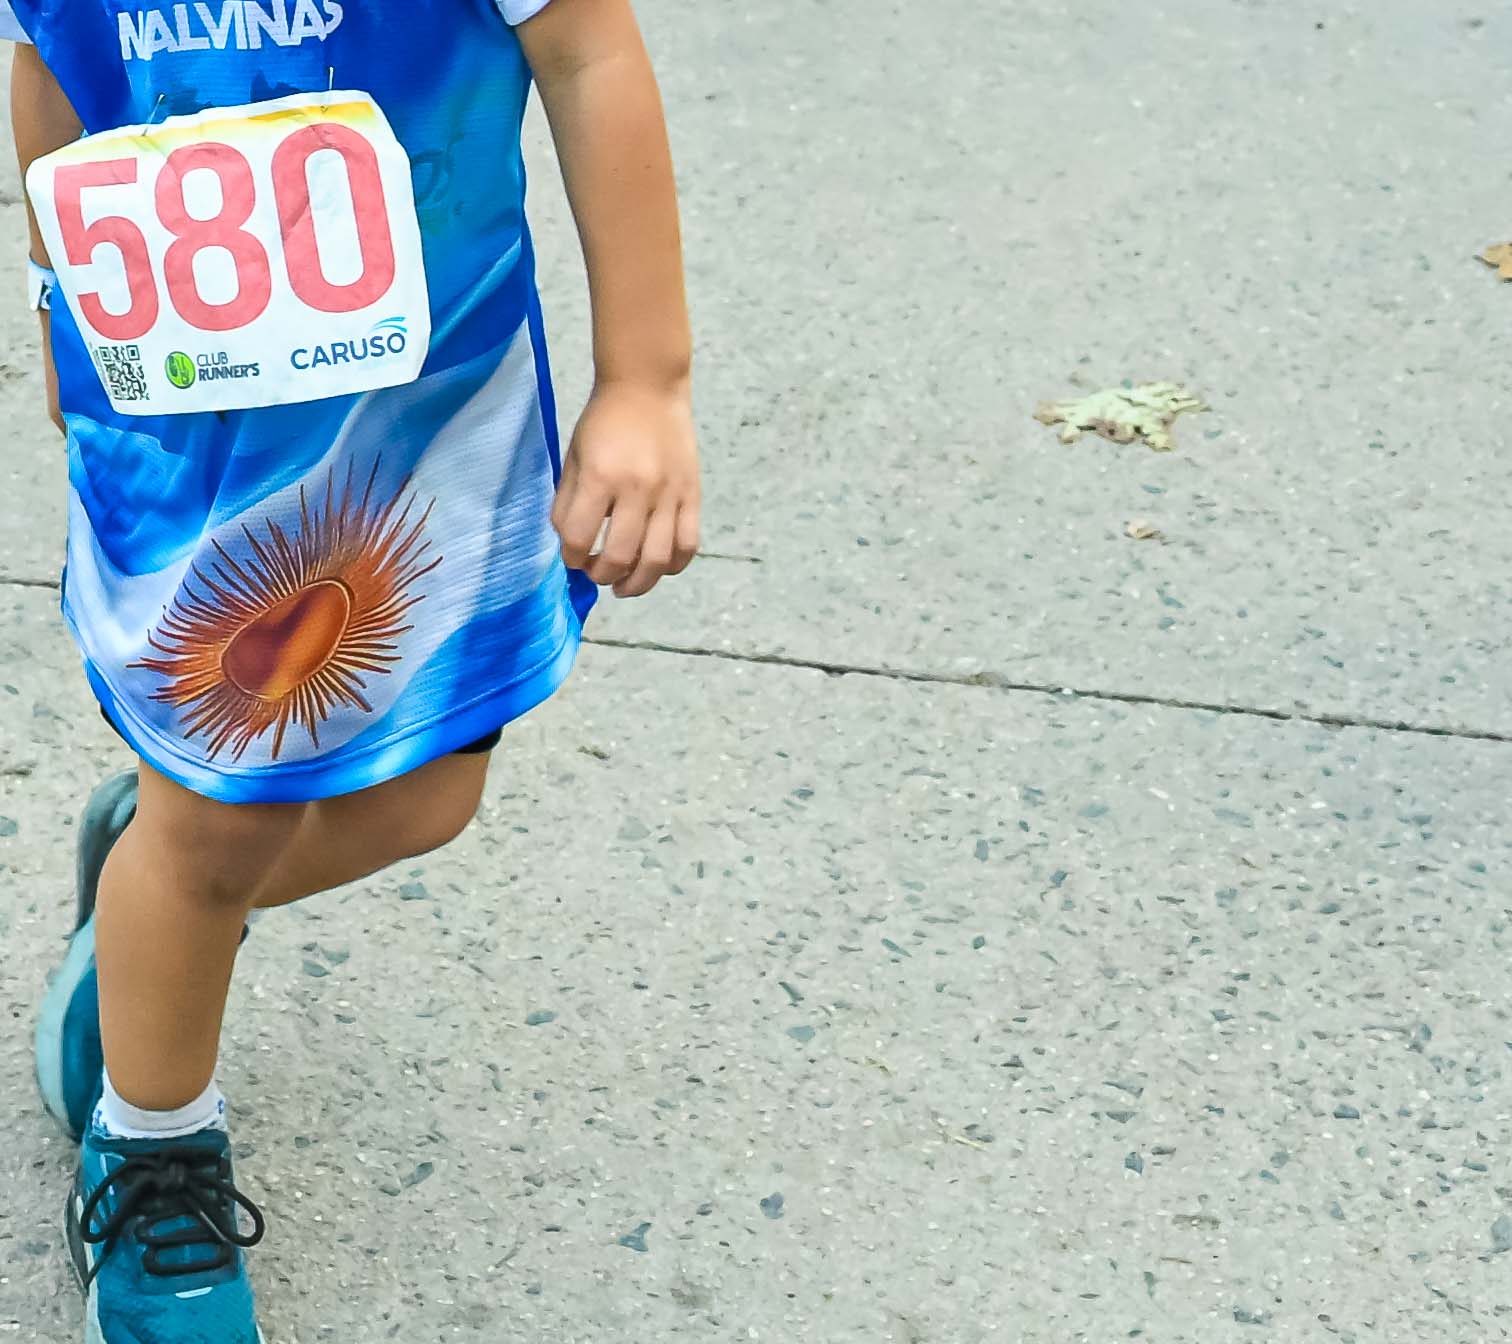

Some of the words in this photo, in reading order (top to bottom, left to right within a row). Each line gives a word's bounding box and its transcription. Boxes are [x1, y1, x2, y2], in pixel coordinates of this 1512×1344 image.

[51, 122, 397, 343] 580
[196, 351, 229, 367] CLUB
[289, 331, 407, 372] CARUSO
